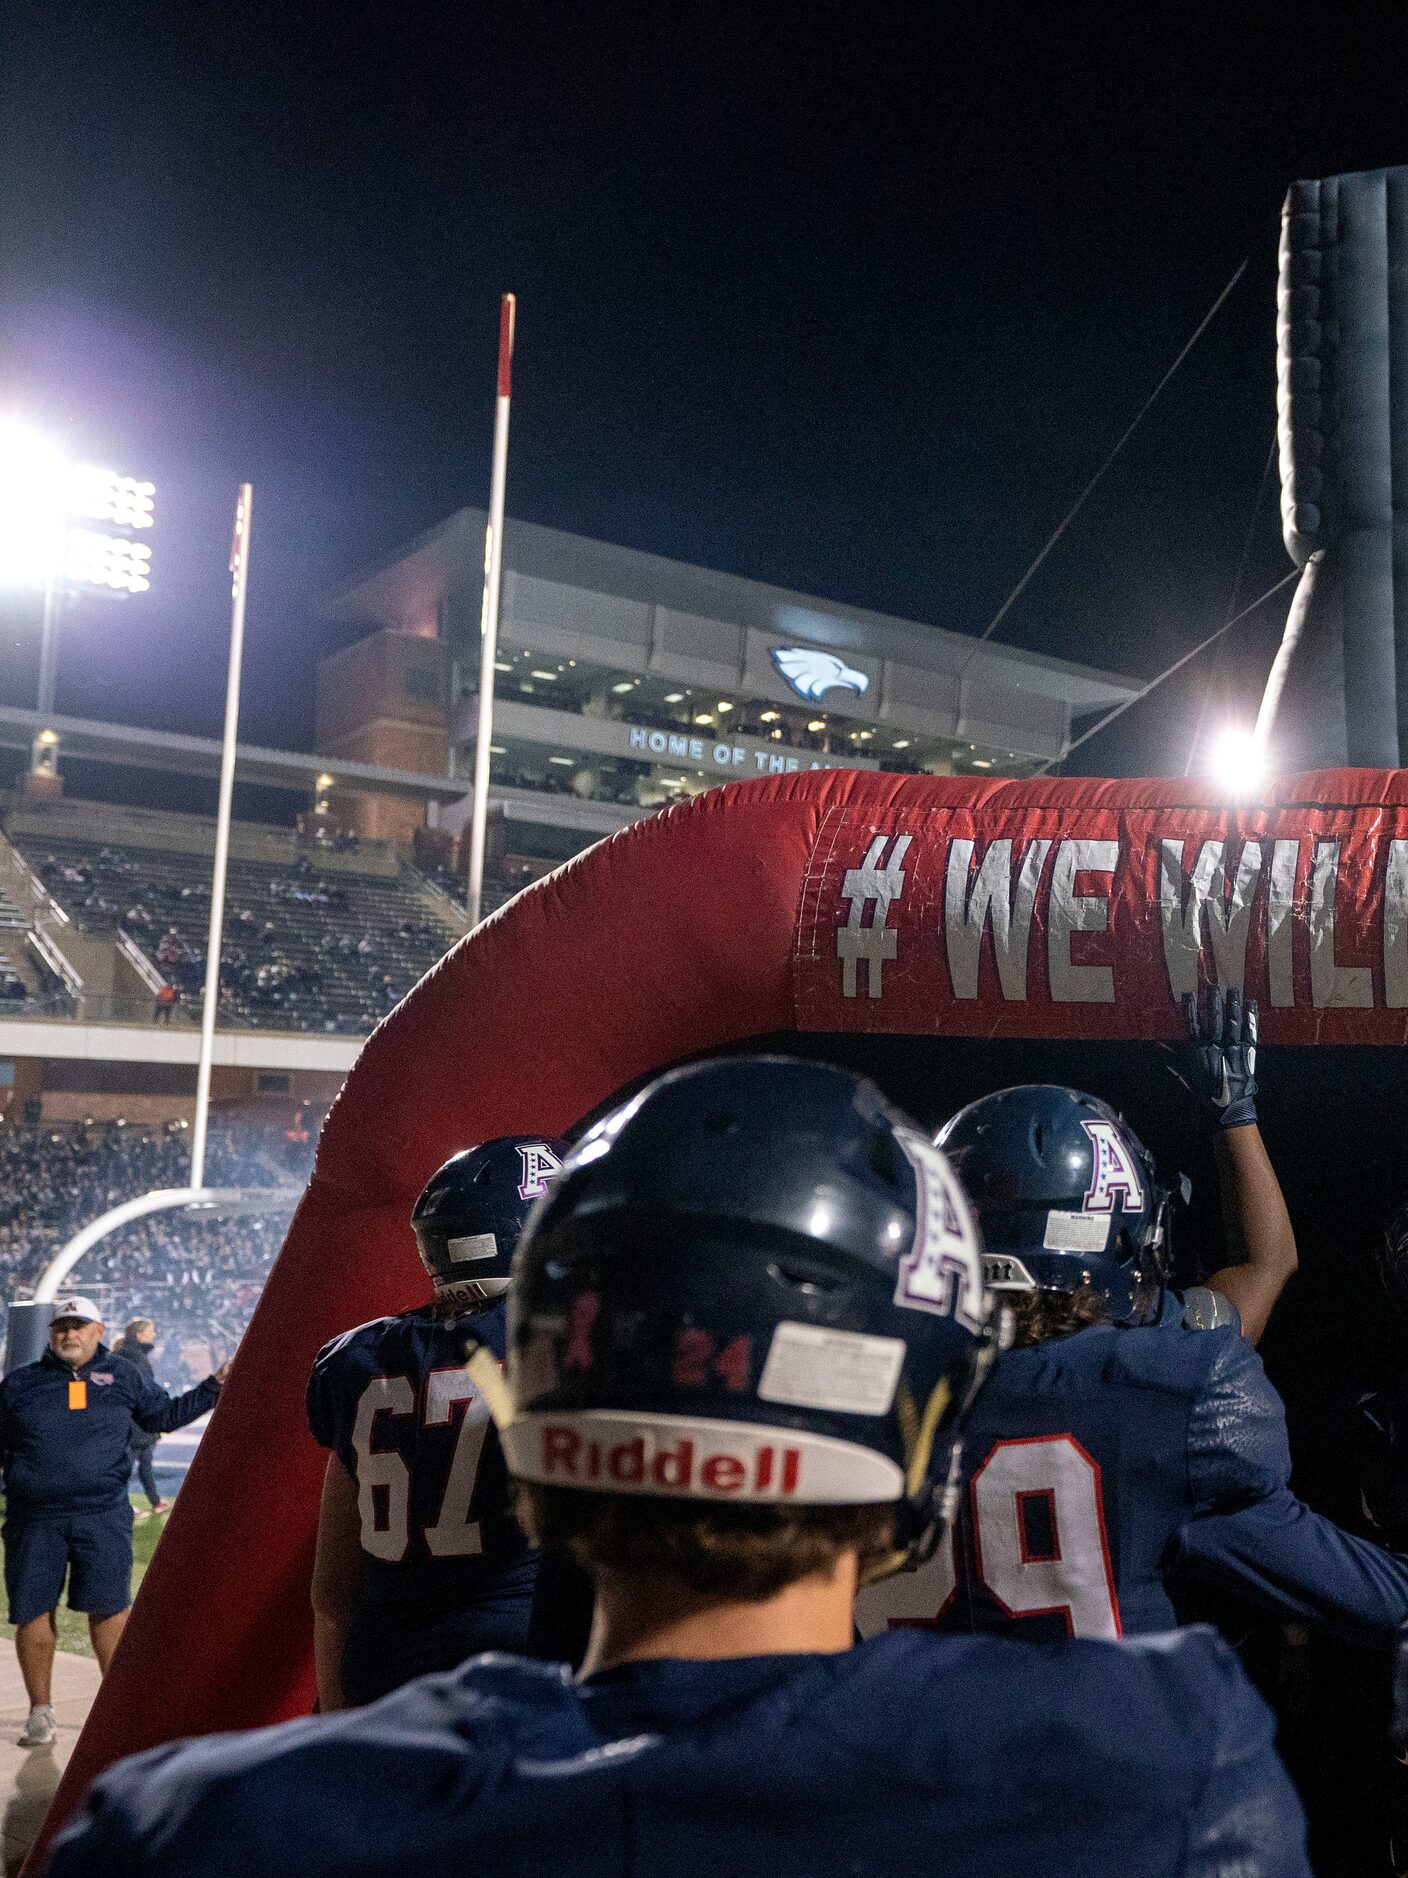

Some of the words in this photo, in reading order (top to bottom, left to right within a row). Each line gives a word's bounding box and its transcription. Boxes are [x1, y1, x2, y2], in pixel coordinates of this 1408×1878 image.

[629, 727, 704, 760] HOME
[713, 743, 747, 767] OF
[755, 751, 800, 774] THE
[944, 838, 1120, 1003] WE
[1081, 1120, 1145, 1213] A
[352, 1361, 506, 1562] 67
[540, 1424, 802, 1496] Riddell
